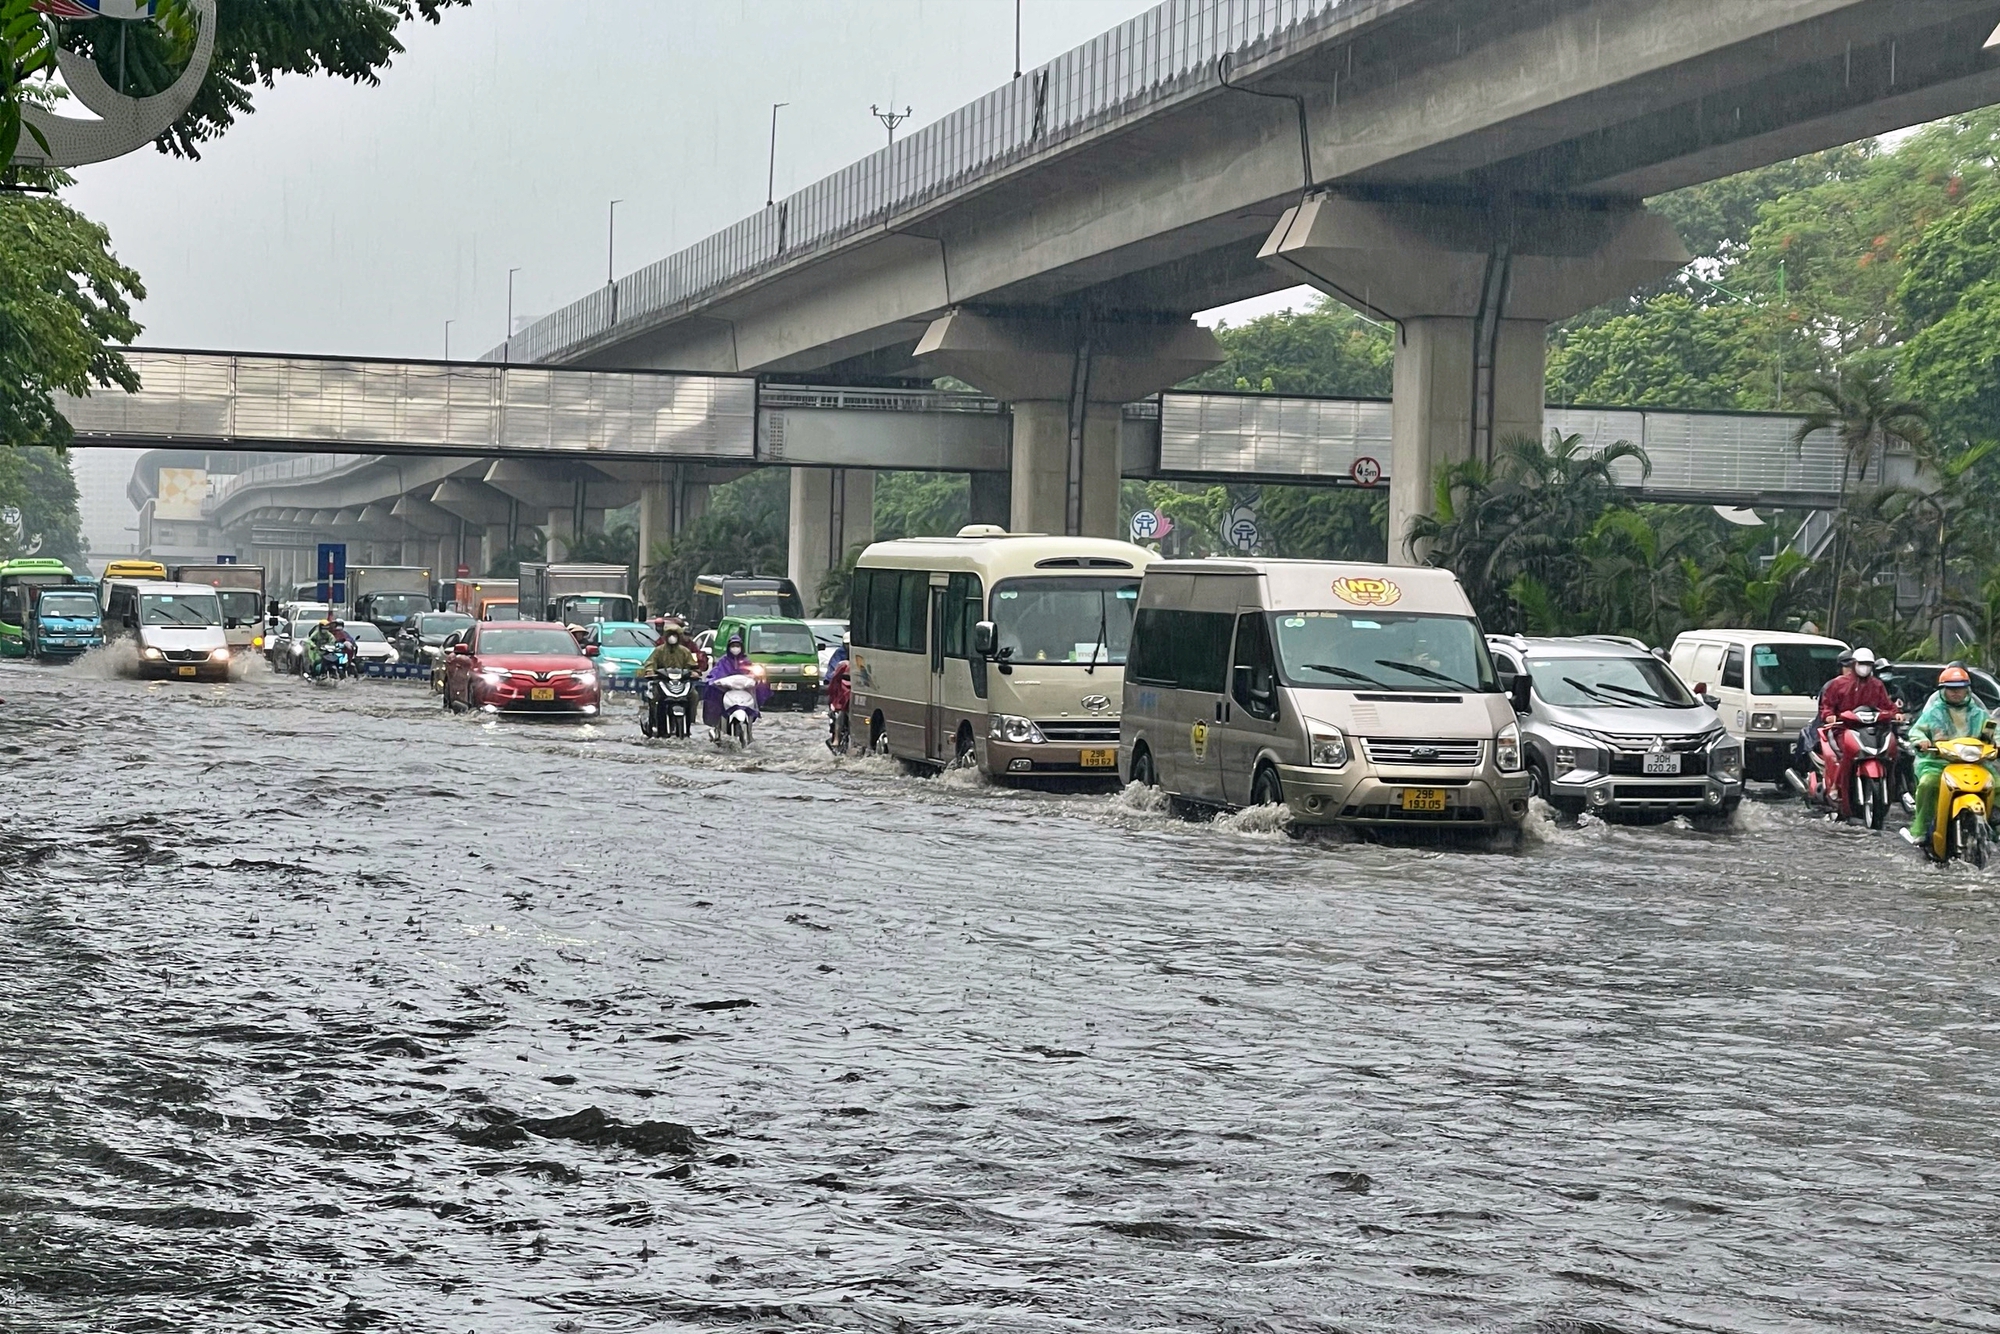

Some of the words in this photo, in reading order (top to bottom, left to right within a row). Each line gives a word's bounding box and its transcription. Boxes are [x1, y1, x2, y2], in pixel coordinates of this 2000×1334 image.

[1347, 580, 1385, 593] ND
[1654, 754, 1671, 763] 30H
[1647, 763, 1677, 772] 020.28
[1415, 789, 1435, 799] 29B
[1408, 799, 1442, 810] 193.05
